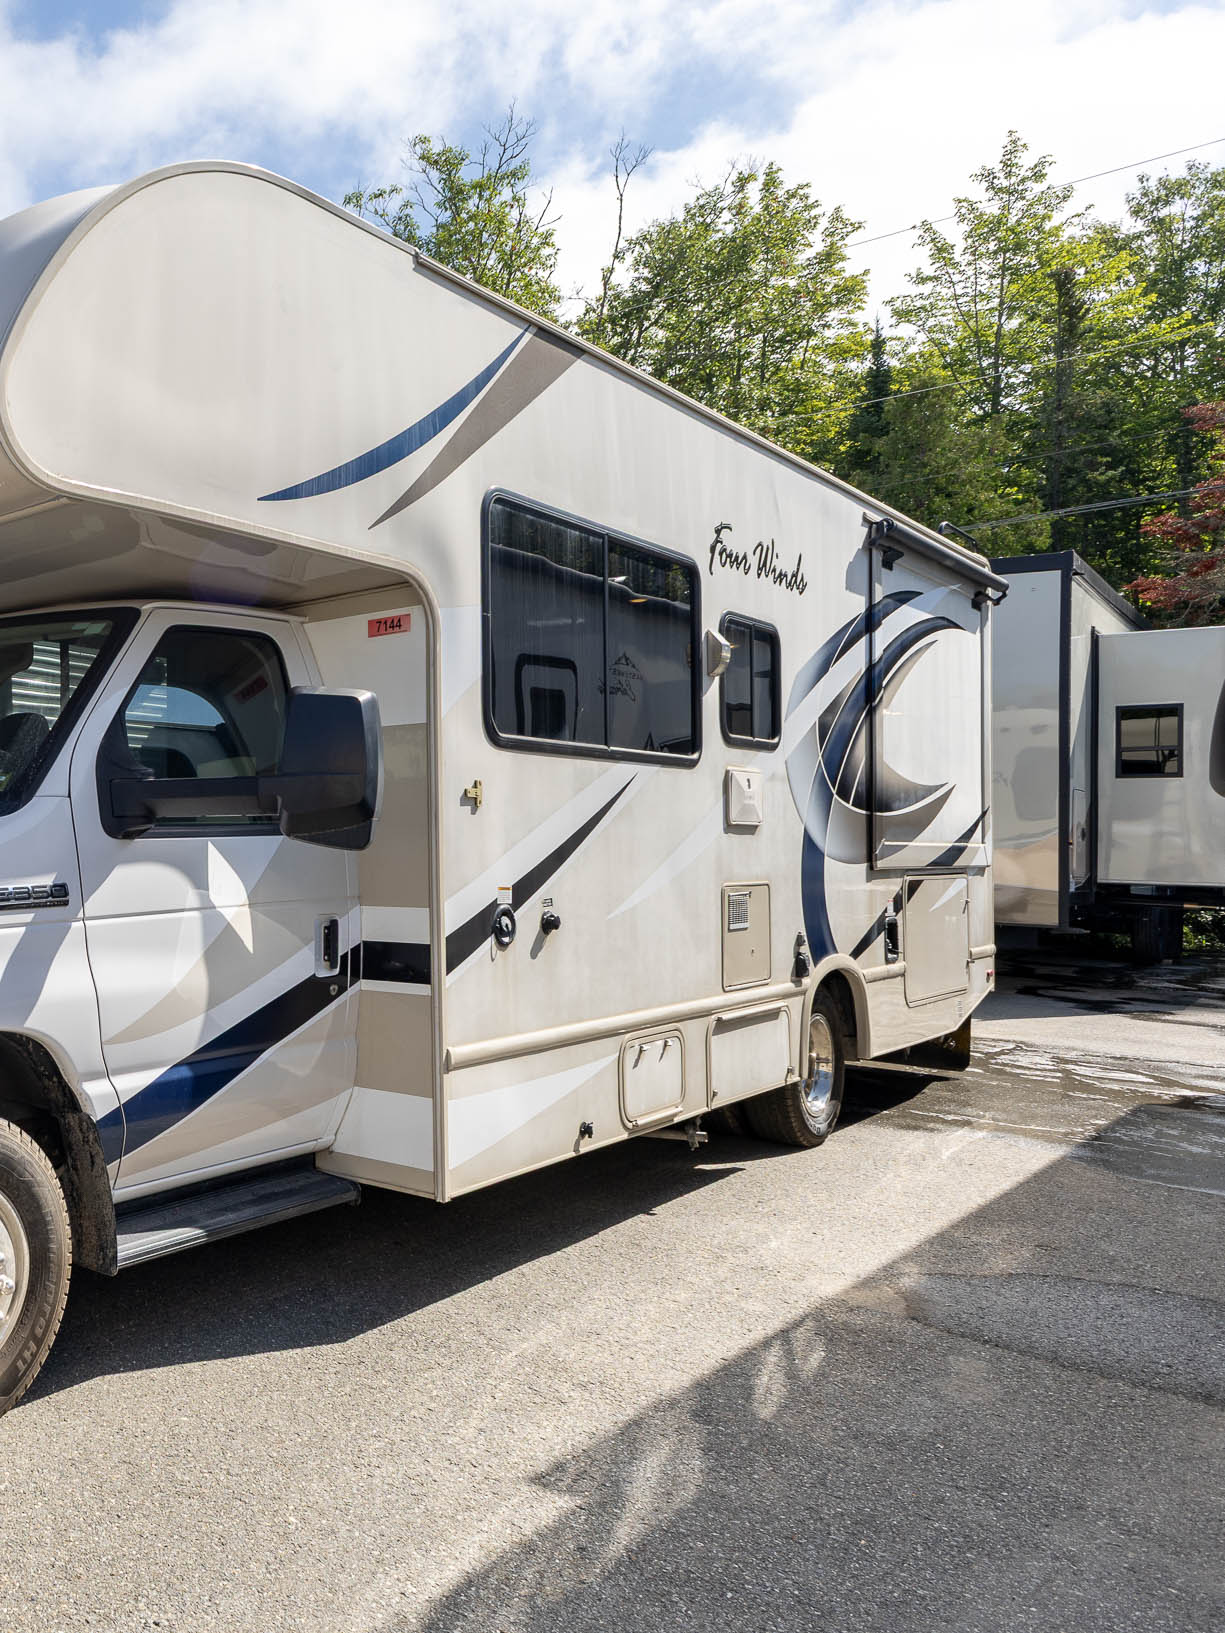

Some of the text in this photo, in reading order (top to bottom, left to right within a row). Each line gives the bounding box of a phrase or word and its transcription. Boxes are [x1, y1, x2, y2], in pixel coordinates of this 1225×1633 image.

[709, 522, 807, 595] Four Winds
[376, 616, 402, 632] 7144
